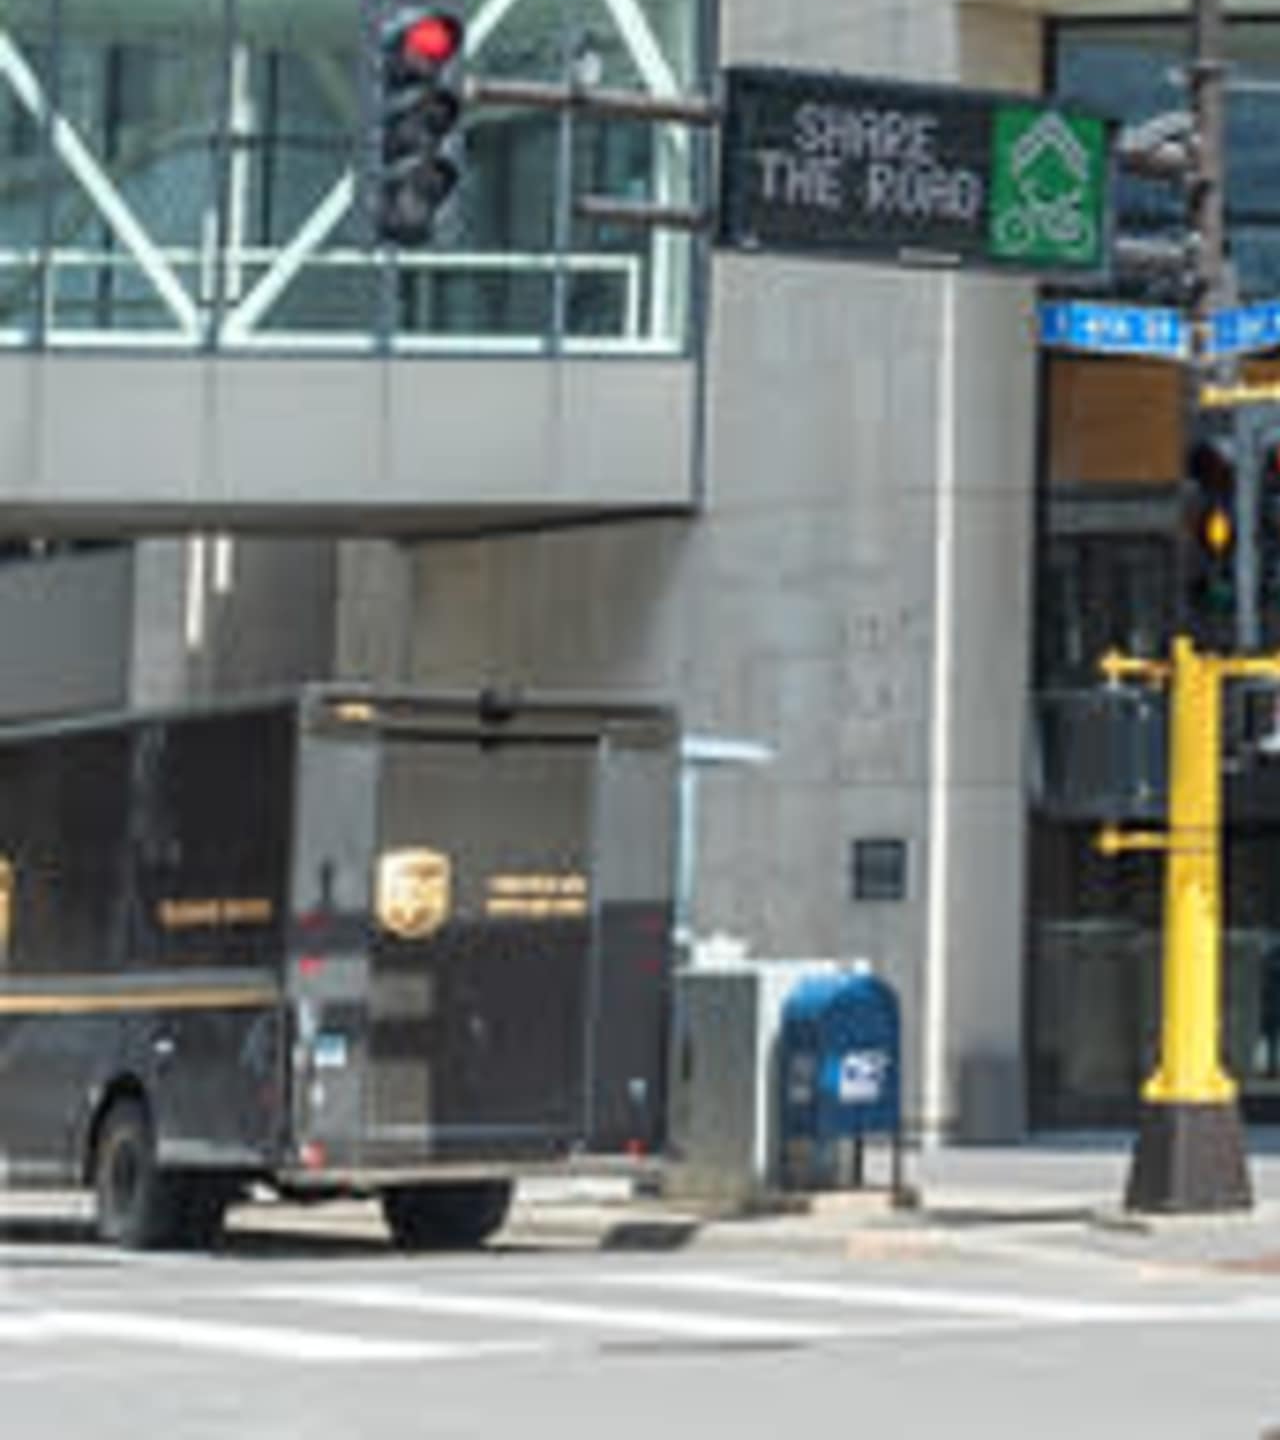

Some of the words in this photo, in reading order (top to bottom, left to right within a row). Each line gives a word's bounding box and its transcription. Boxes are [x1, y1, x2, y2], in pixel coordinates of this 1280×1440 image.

[795, 104, 938, 163] SHARE
[757, 148, 842, 208] THE
[866, 162, 984, 222] ROAD
